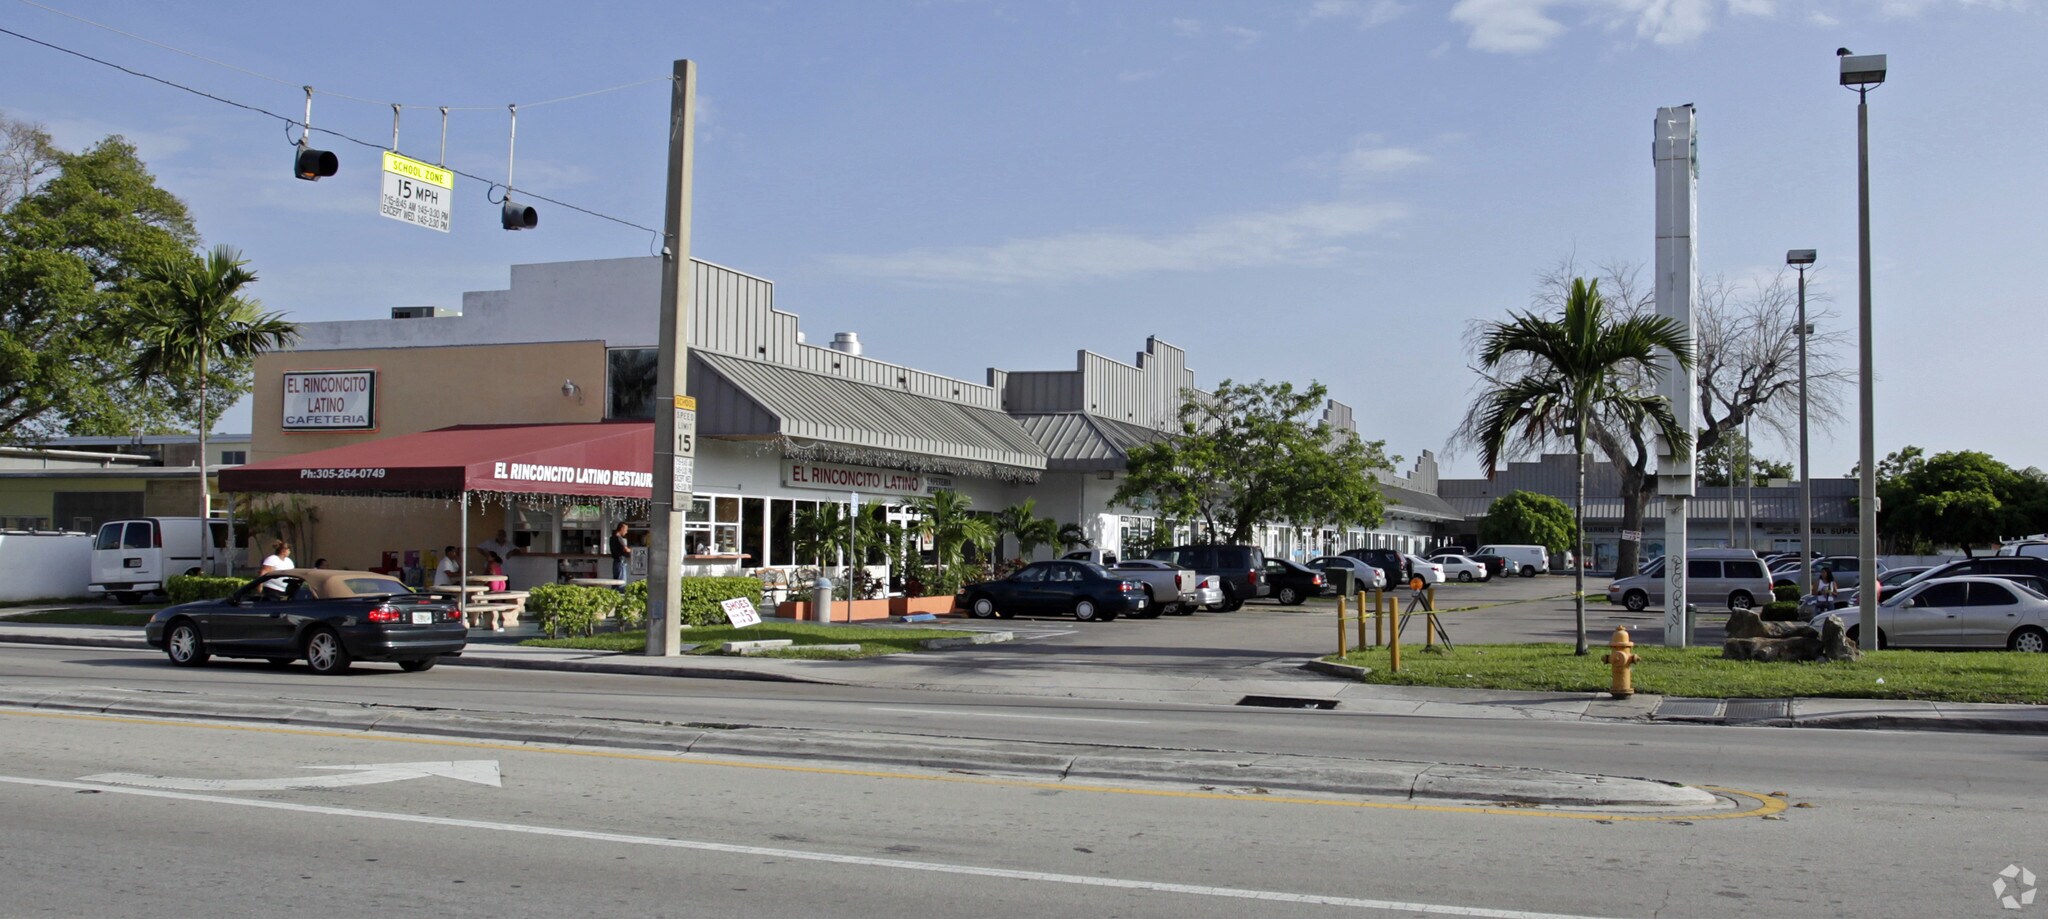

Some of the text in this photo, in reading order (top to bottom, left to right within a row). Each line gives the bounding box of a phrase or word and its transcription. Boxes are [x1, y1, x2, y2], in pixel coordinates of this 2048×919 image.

[393, 160, 444, 184] SCHOOL ZONE
[398, 179, 439, 205] 15 MPH
[382, 204, 402, 217] EXCEPT
[440, 221, 448, 231] PM
[408, 202, 417, 212] AM
[441, 211, 449, 221] PM
[287, 376, 367, 394] EL RINCONCITO
[307, 397, 345, 413] LATINO
[285, 415, 366, 425] CAFETERIA
[676, 411, 694, 421] SPEED
[677, 421, 692, 431] LIMIT
[678, 433, 692, 453] 15
[300, 468, 386, 479] Ph:305-264-0749
[494, 461, 508, 479] EL
[510, 463, 575, 483] RINCONCITO
[575, 467, 611, 486] LATINO
[611, 470, 653, 488] RESTAUR
[792, 465, 919, 492] EL RINCONCITO LATINO
[571, 504, 600, 517] OPEN
[1793, 527, 1826, 535] DTAL
[724, 599, 750, 611] SHOES
